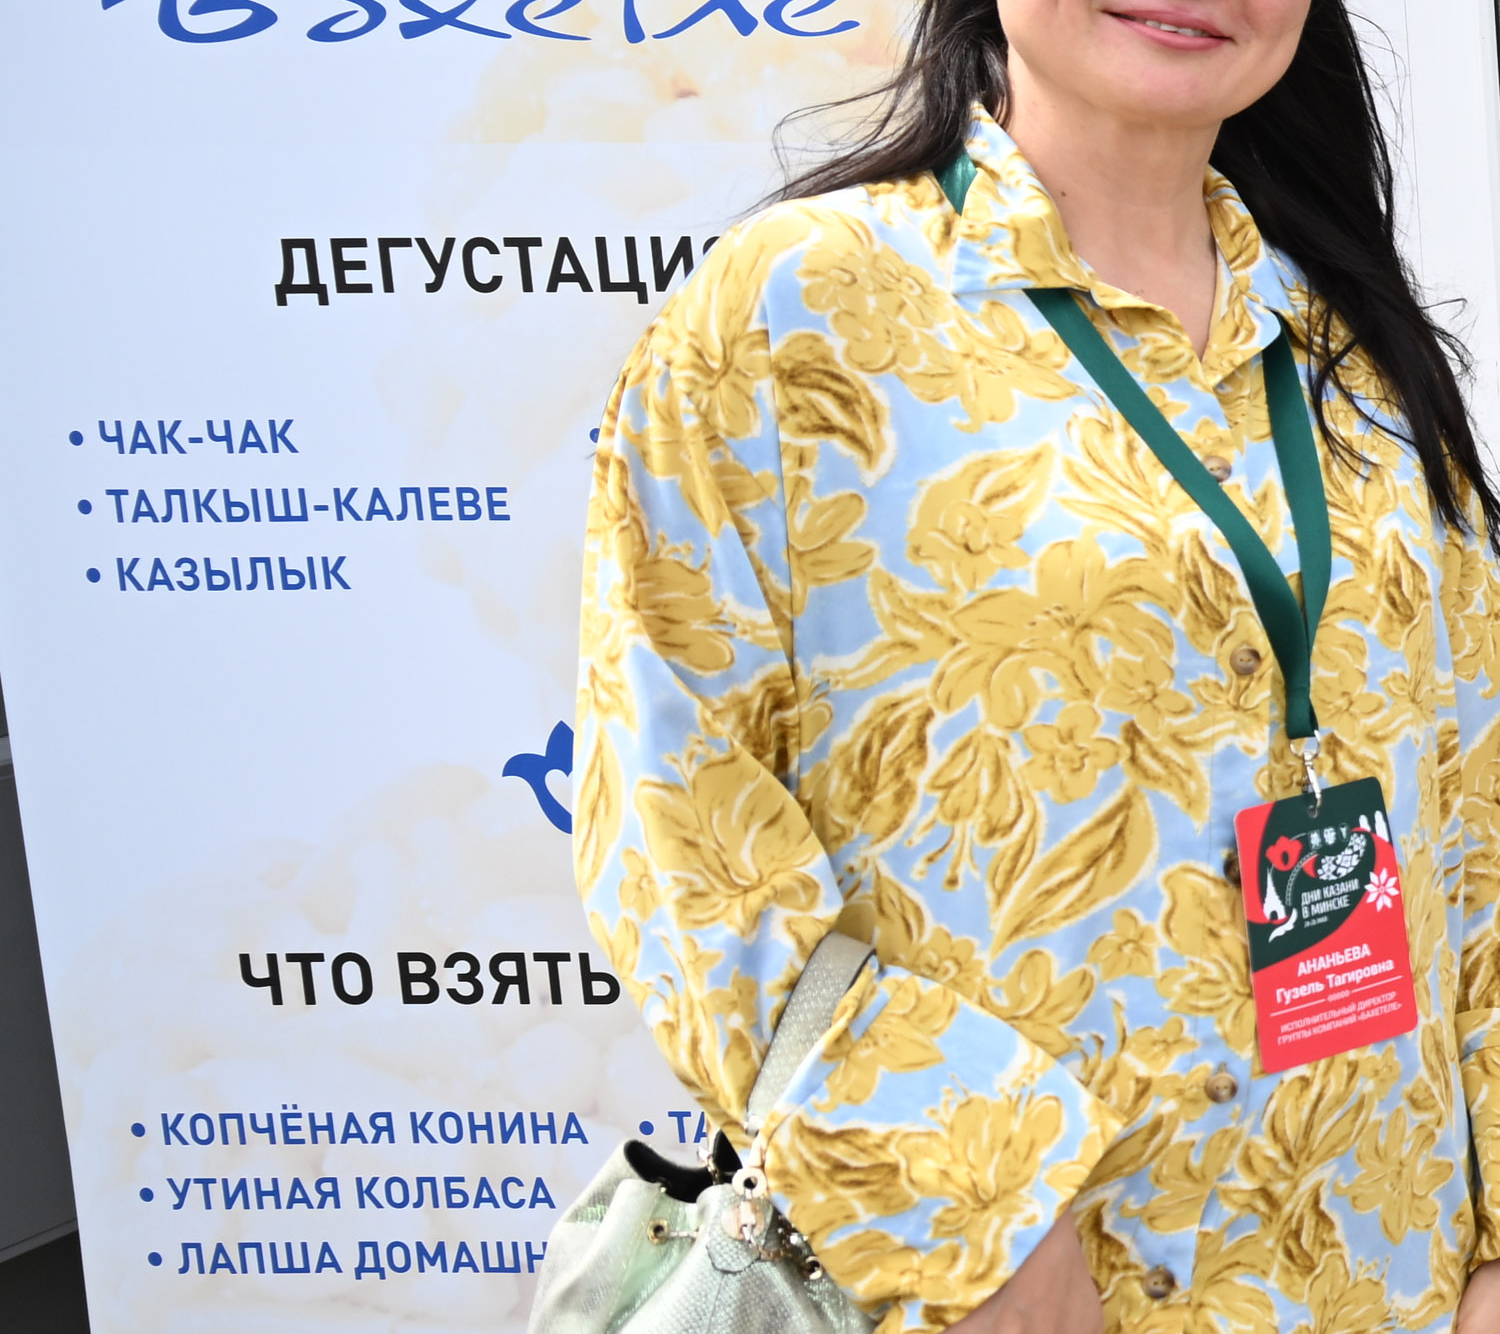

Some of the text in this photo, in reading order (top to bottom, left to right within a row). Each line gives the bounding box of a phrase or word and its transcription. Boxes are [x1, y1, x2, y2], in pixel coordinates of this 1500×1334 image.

[274, 235, 718, 307] ДЕГУСТАЦИ
[98, 419, 299, 454] ЧАК-ЧАК
[105, 487, 510, 523] ТАЛКЫШ-КАЛЕВЕ
[117, 556, 351, 591] КАЗЫЛЫК
[1301, 878, 1360, 908] ДНИ КАЗАНИ
[1302, 894, 1351, 919] В МИНСКЕ
[1297, 943, 1371, 977] АНАНЬЕВА
[239, 951, 621, 1006] ЧТО ВЗЯТЬ
[1276, 959, 1395, 1005] Гузель Тагировна
[161, 1104, 588, 1145] КОПЧЁНАЯ КОНИНА
[166, 1177, 556, 1210] УТИНАЯ КОЛБАСА
[178, 1242, 343, 1274] ЛАПША
